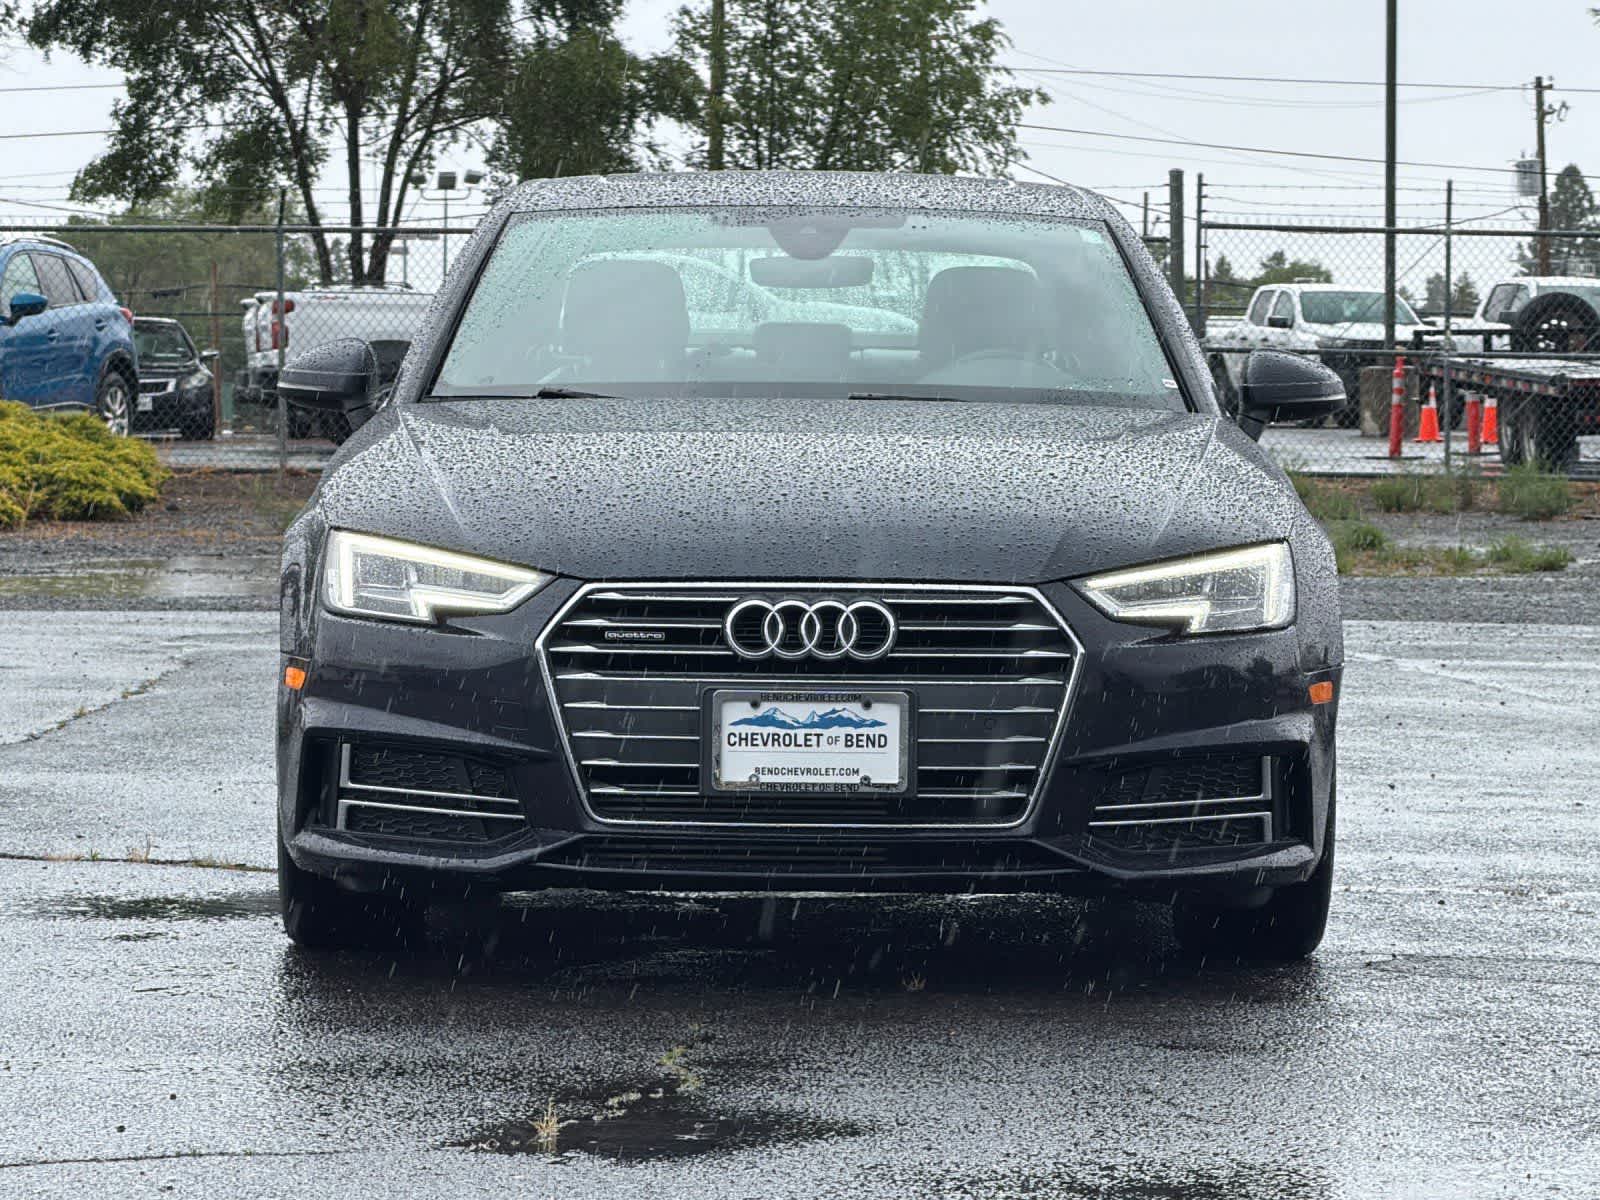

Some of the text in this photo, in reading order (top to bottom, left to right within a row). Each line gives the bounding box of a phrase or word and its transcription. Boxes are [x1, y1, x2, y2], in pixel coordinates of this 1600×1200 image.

[727, 732, 888, 748] CHEVROLET OF BEND
[755, 767, 860, 776] BENDCHEVROLET.COM
[760, 782, 817, 792] CHEVROLET
[834, 783, 860, 792] BEND
